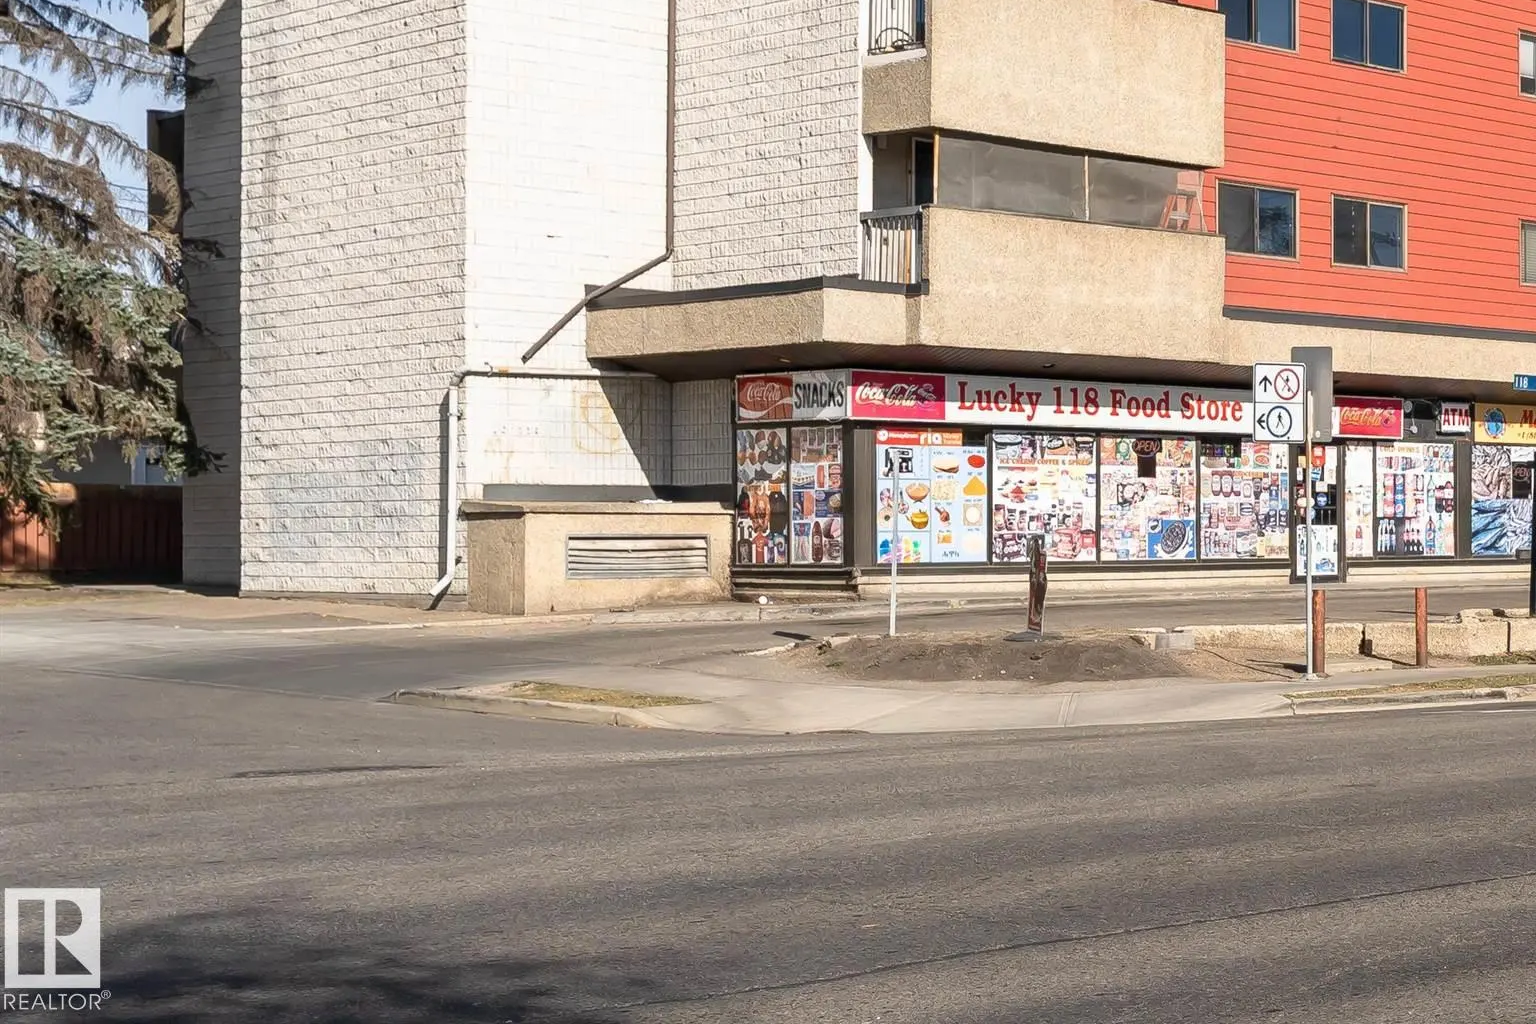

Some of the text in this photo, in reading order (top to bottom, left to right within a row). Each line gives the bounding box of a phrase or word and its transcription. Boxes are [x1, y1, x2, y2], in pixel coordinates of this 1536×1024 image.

[1515, 376, 1528, 389] 118
[794, 381, 844, 409] SNACKS
[957, 381, 1243, 422] Lucky 118 Food Store
[1443, 408, 1470, 426] ATM
[1134, 440, 1157, 452] OPEN
